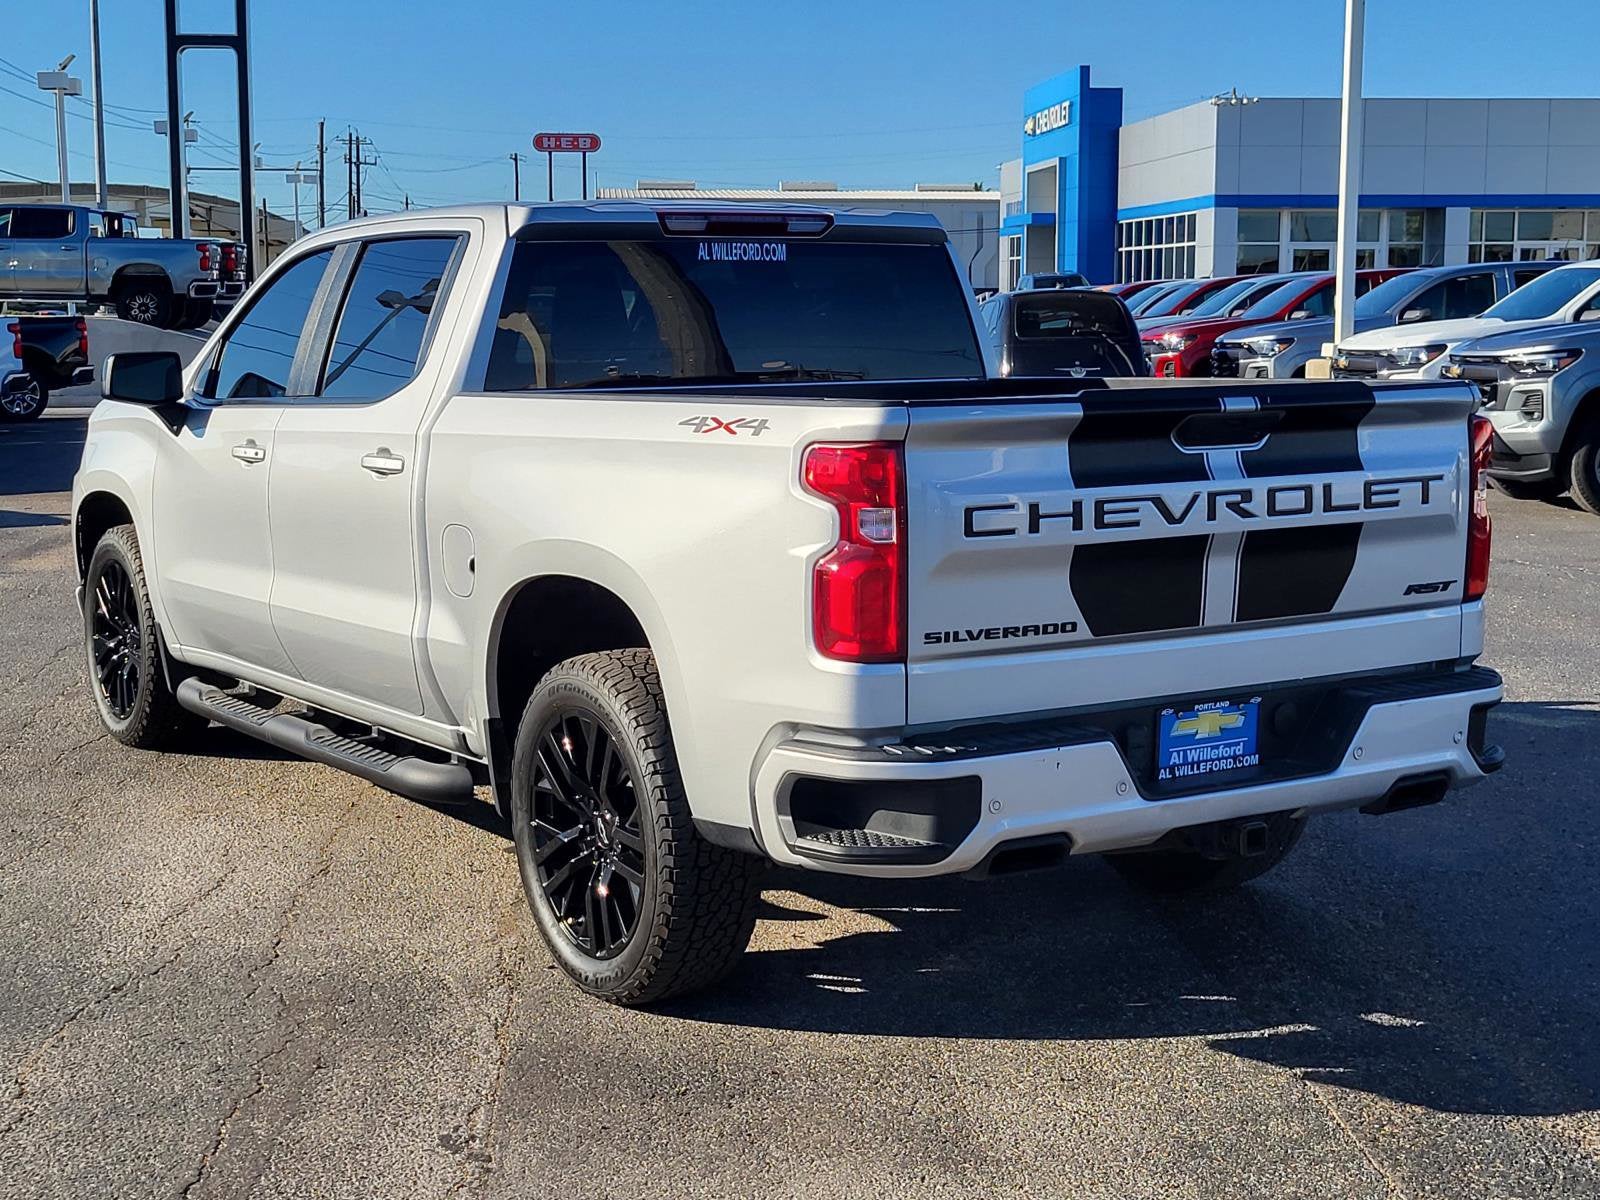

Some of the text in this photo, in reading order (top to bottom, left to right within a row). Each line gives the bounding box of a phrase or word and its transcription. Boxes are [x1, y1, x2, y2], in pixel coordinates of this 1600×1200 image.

[1036, 100, 1070, 135] CHEVROLET
[698, 242, 787, 262] AL WILLEFORD.COM
[963, 474, 1444, 538] CHEVROLET
[1403, 580, 1458, 596] RST
[923, 621, 1078, 645] SILVERADO
[1194, 701, 1230, 711] PORTLAND
[1169, 742, 1244, 765] Al Willeford
[1159, 754, 1259, 780] AL WILLEFORD.COM
